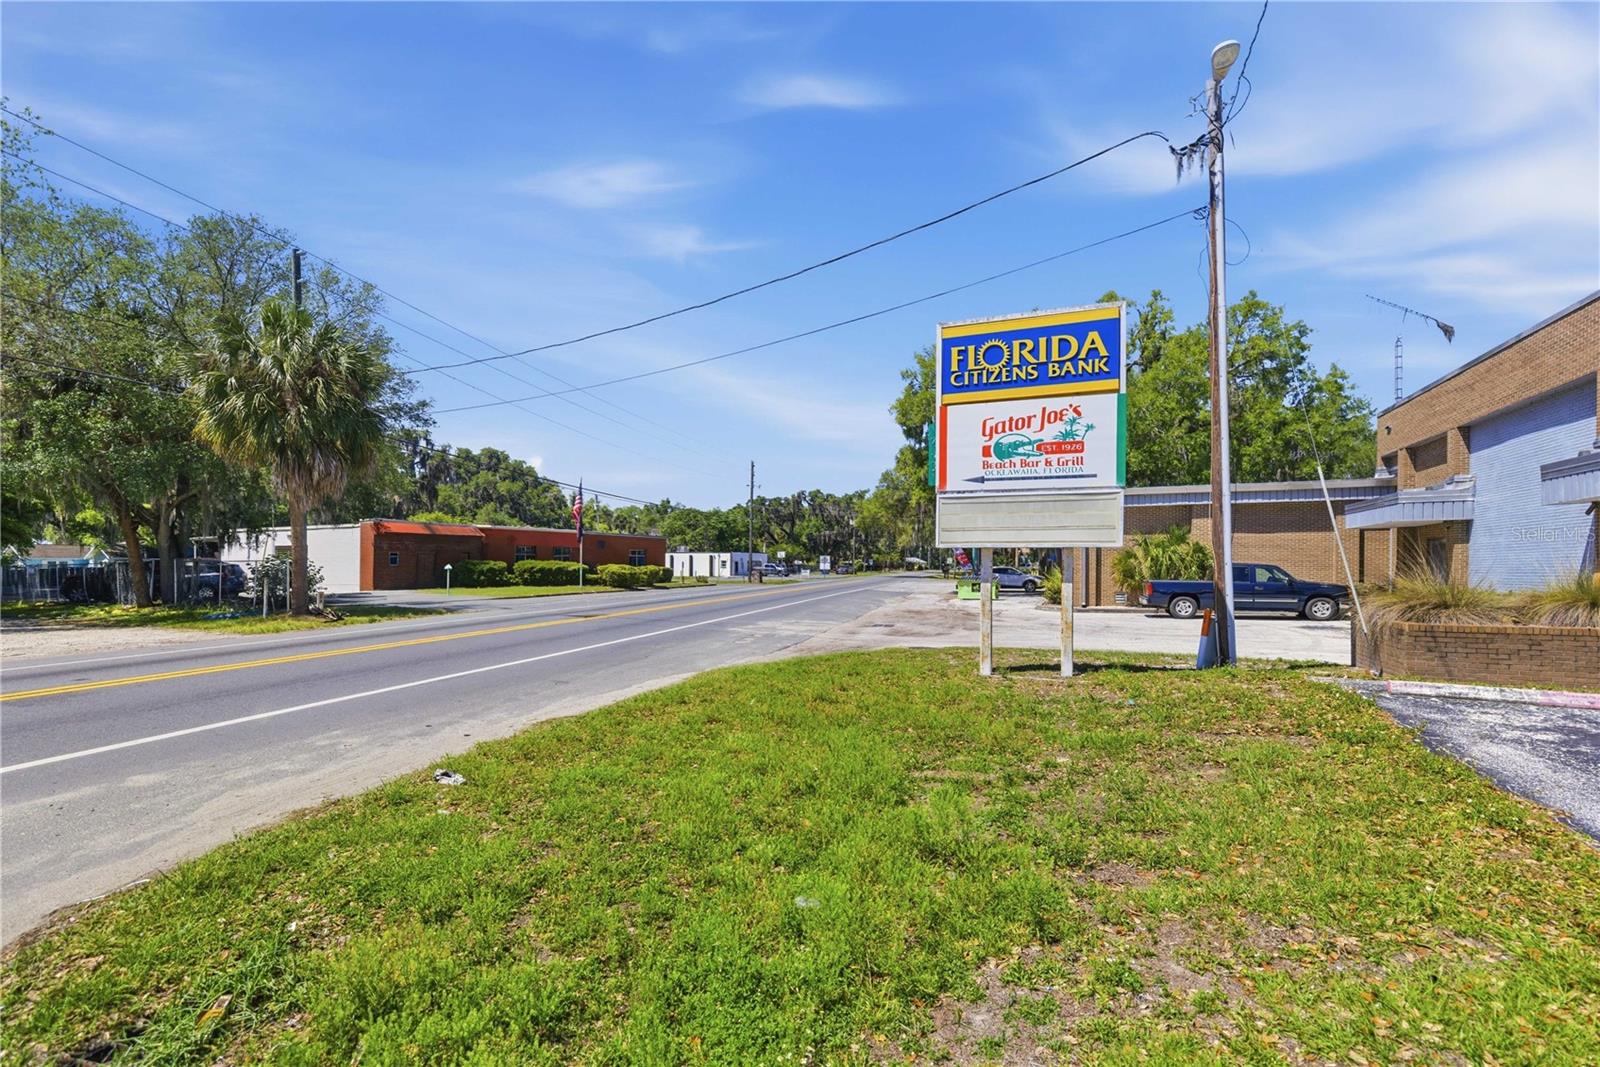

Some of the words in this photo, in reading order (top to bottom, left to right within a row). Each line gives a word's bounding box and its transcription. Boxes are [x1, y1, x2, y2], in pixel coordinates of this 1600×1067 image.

[950, 331, 1109, 372] FLORIDA
[950, 364, 1038, 387] CITIZENS
[1048, 357, 1110, 378] BANK
[981, 416, 1037, 443] Gator
[1032, 403, 1083, 434] Joe's
[1041, 444, 1059, 452] EST.
[1061, 443, 1083, 451] 1926
[982, 459, 1016, 470] Beach
[1020, 458, 1042, 469] Bar
[1044, 456, 1054, 467] &
[1056, 455, 1084, 467] Grill
[1043, 466, 1084, 474] FLORIDA
